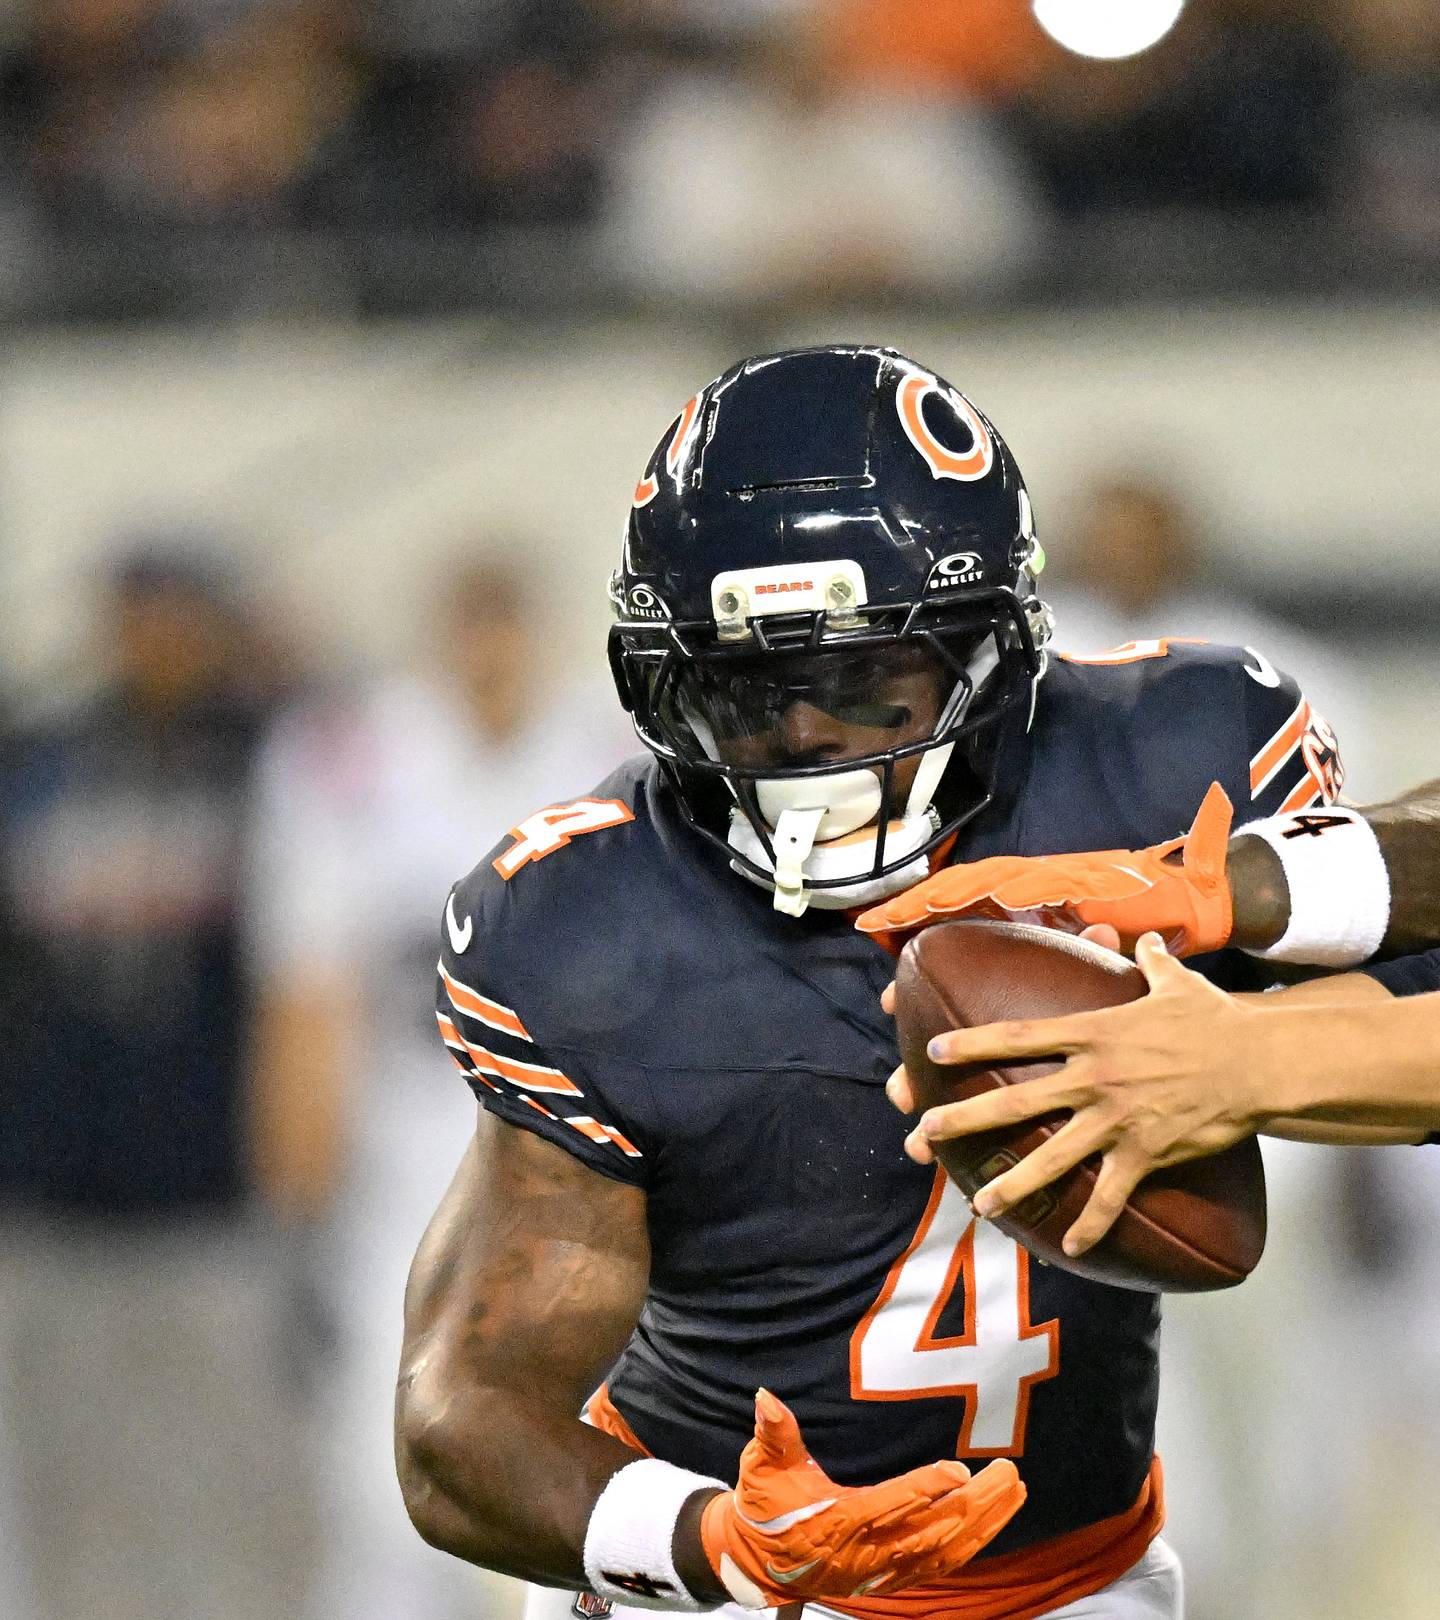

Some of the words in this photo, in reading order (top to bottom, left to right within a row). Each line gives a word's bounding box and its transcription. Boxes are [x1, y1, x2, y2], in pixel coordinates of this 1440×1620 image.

[755, 581, 814, 595] BEARS
[929, 570, 984, 590] OAKLEY
[630, 606, 663, 618] OAKLEY
[492, 797, 635, 881] 4
[1281, 814, 1354, 841] 4
[849, 1165, 1060, 1459] 4
